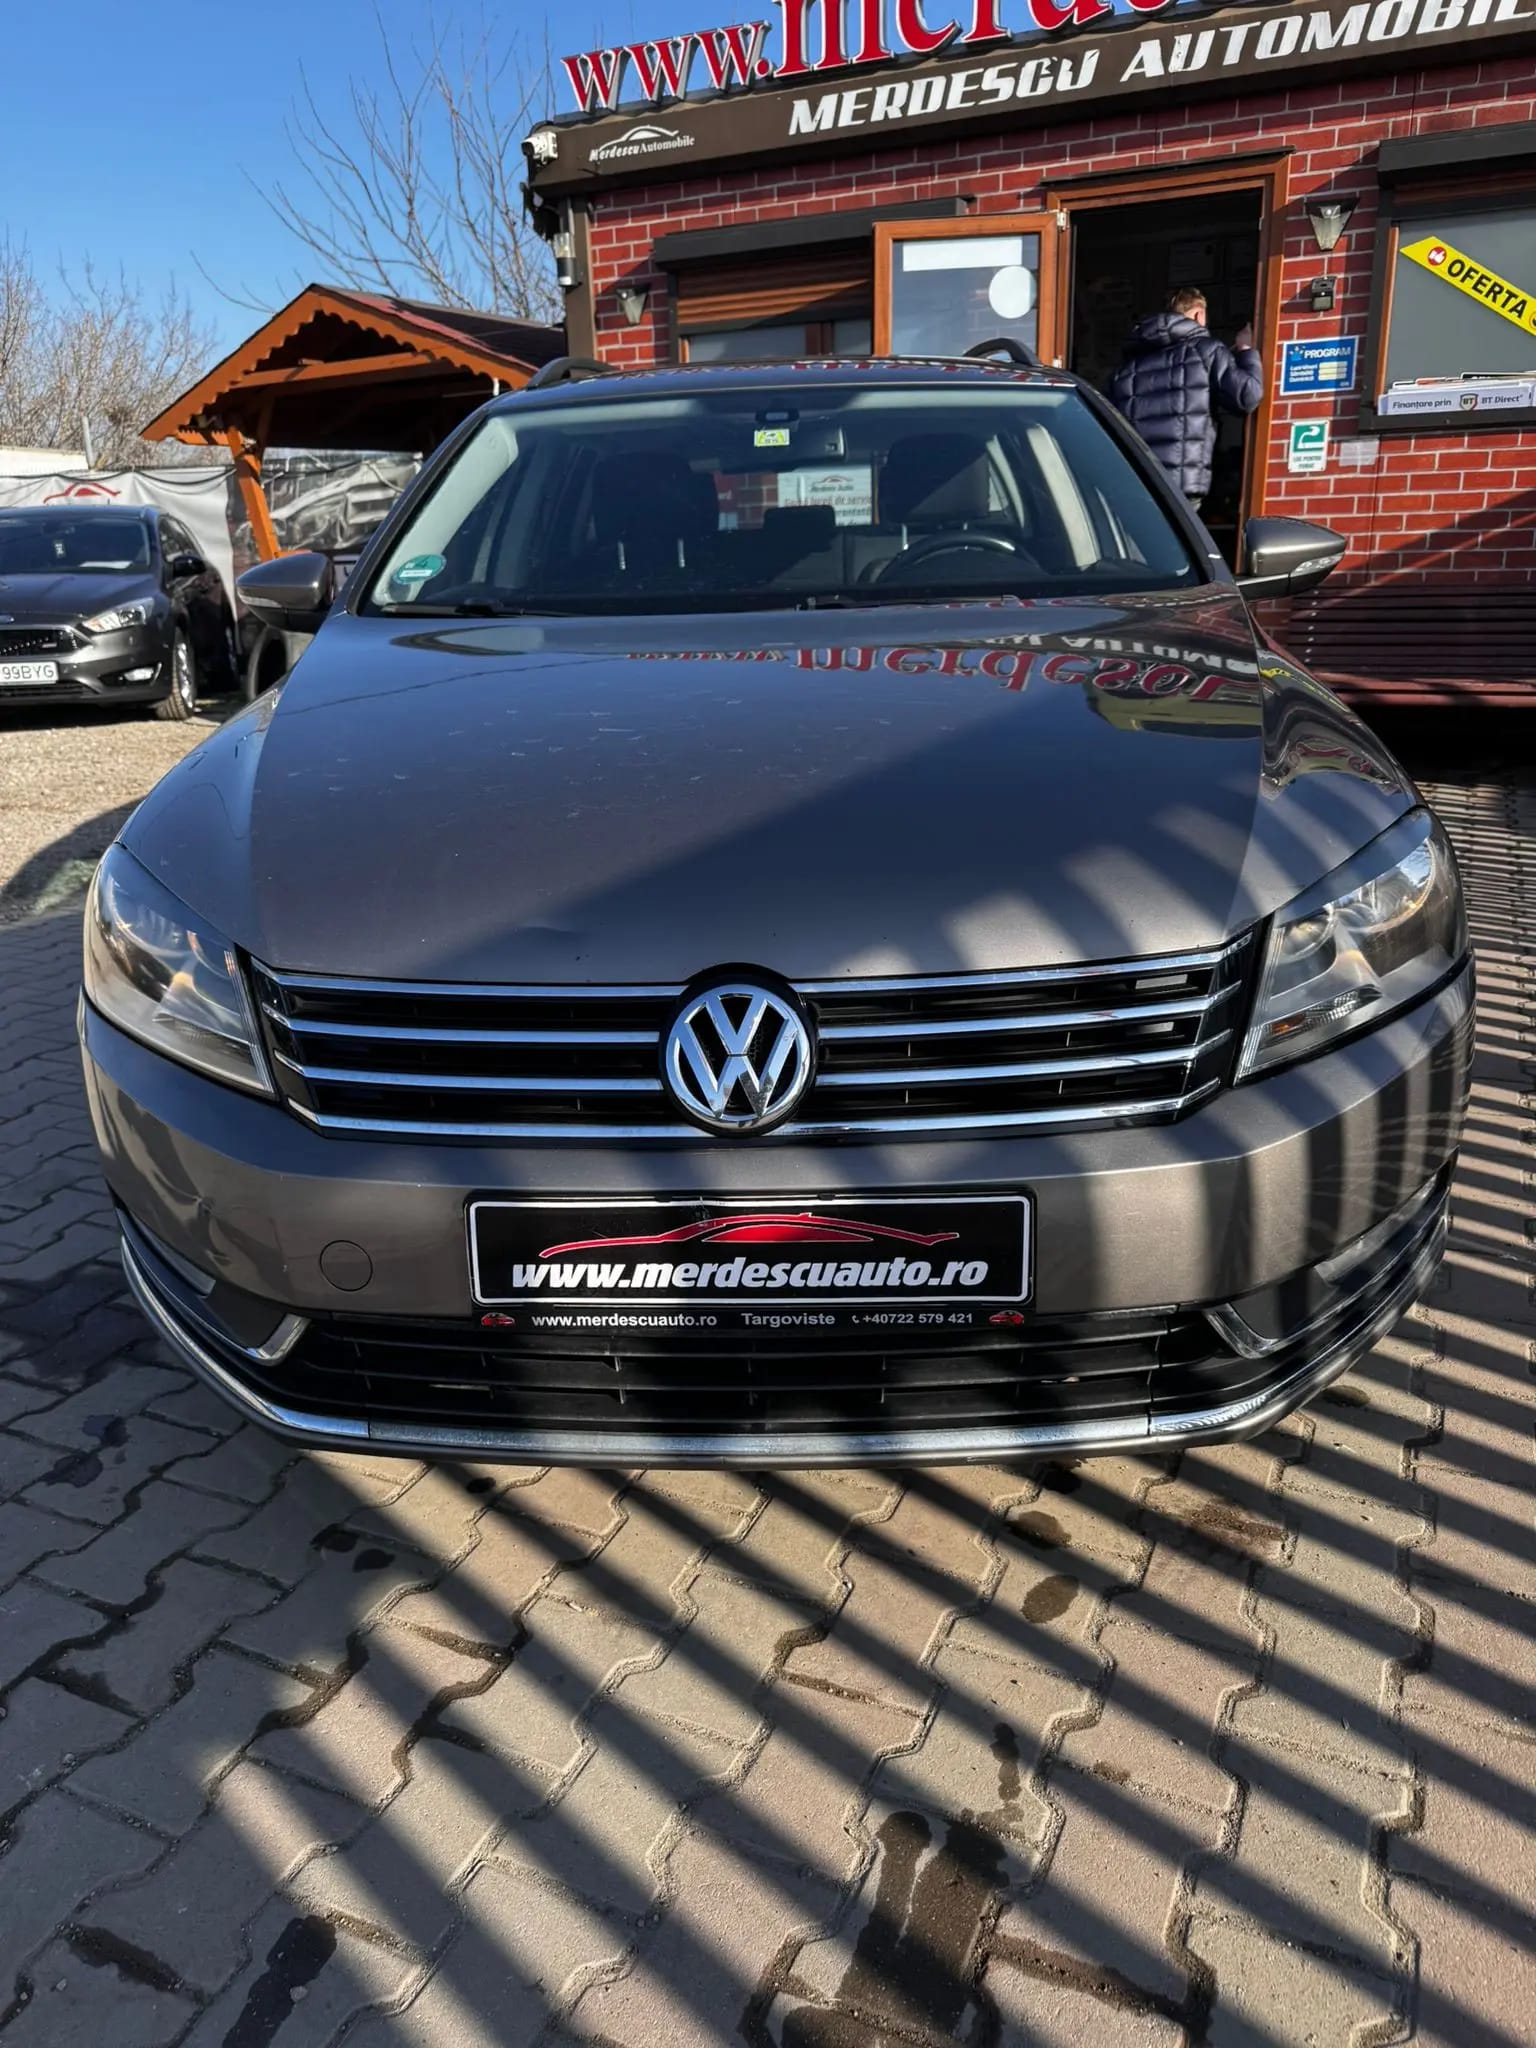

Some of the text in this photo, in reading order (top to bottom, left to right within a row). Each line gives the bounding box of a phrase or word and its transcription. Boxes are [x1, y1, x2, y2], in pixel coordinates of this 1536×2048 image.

[788, 49, 1099, 136] MERDESCU
[1447, 258, 1528, 320] OFERTA
[1304, 346, 1351, 359] PROGRAM
[1434, 398, 1452, 408] prin
[1481, 396, 1492, 404] BT
[1494, 395, 1519, 404] Direct
[512, 1257, 989, 1288] www.merdescuauto.ro
[531, 1313, 973, 1328] www.merdescuauto.ro Targoviste +40722 579 421
